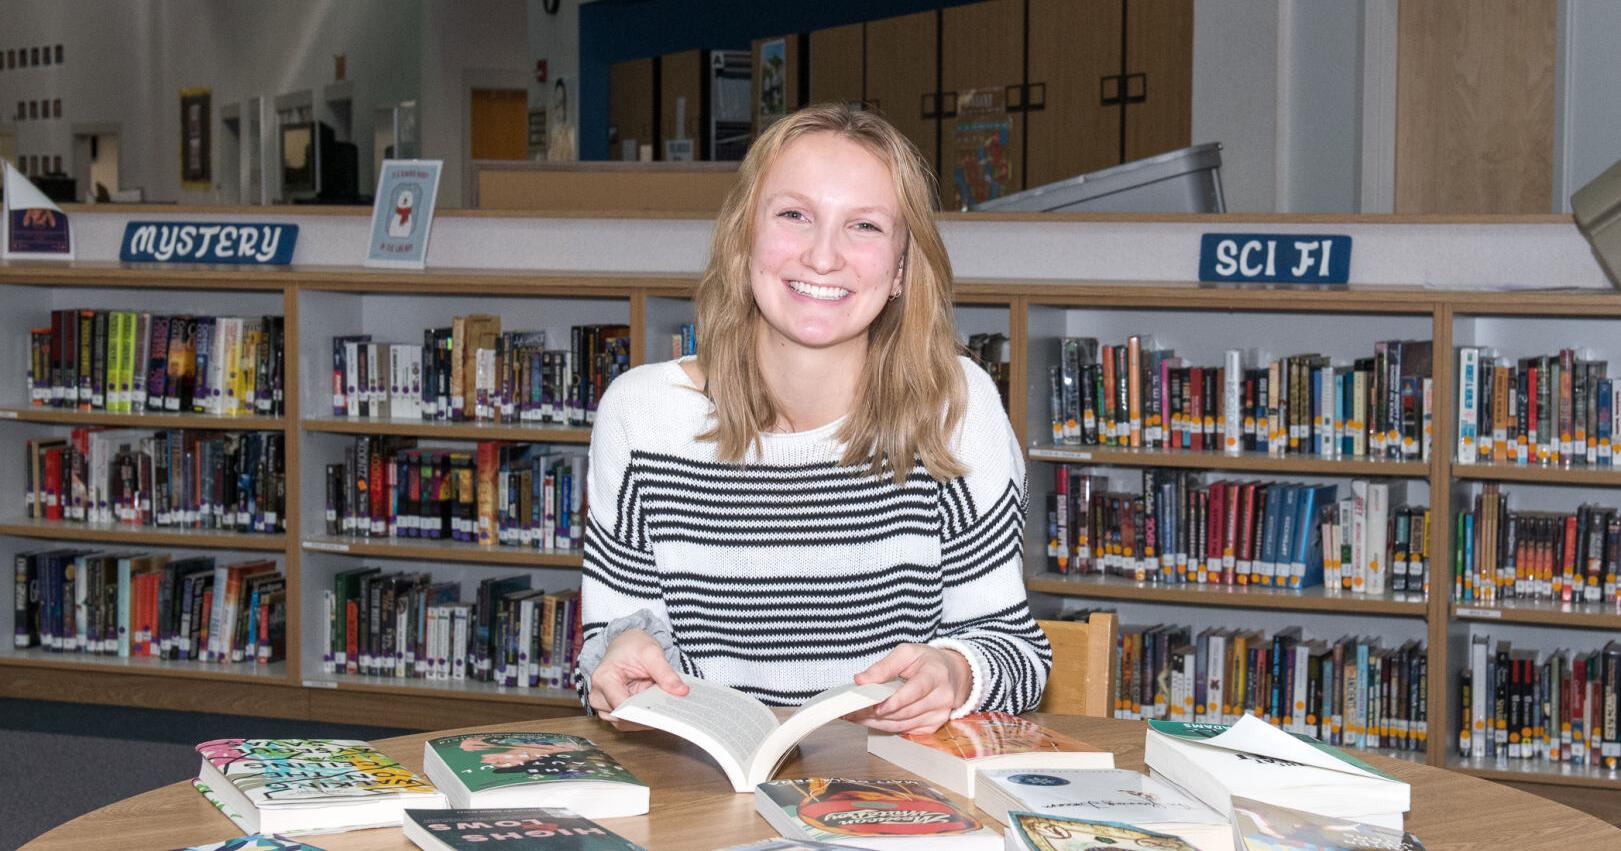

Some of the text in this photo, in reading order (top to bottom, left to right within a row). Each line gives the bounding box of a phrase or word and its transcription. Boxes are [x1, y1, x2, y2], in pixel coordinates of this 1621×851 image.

[130, 223, 283, 262] MYSTERY
[1215, 239, 1333, 277] SCI FI
[1183, 723, 1233, 732] ADAMS
[243, 761, 380, 769] CEILING
[262, 771, 395, 781] ON THE
[265, 778, 425, 790] WALKING
[428, 819, 543, 831] LOWS
[461, 827, 607, 842] HIGHS
